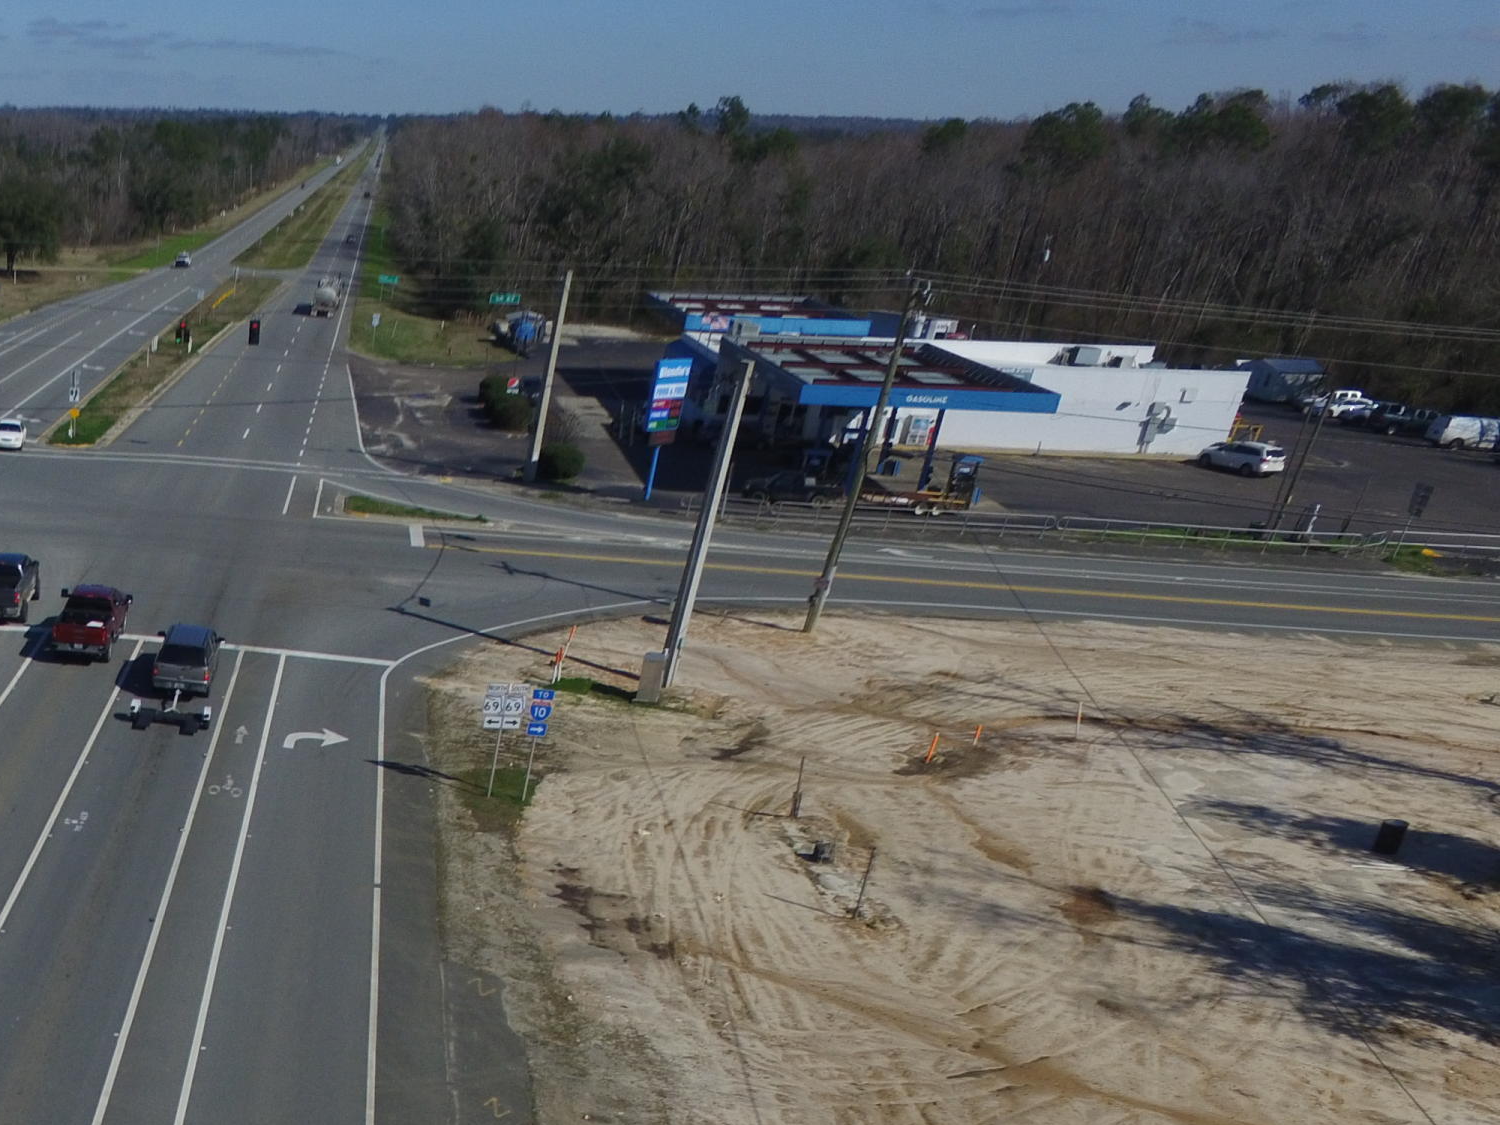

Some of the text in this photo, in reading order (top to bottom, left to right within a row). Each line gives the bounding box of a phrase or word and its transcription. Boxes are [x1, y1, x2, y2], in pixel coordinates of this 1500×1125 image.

[906, 395, 948, 404] GASOLINE
[484, 701, 500, 711] 69
[505, 702, 521, 711] 69
[534, 707, 547, 718] 10
